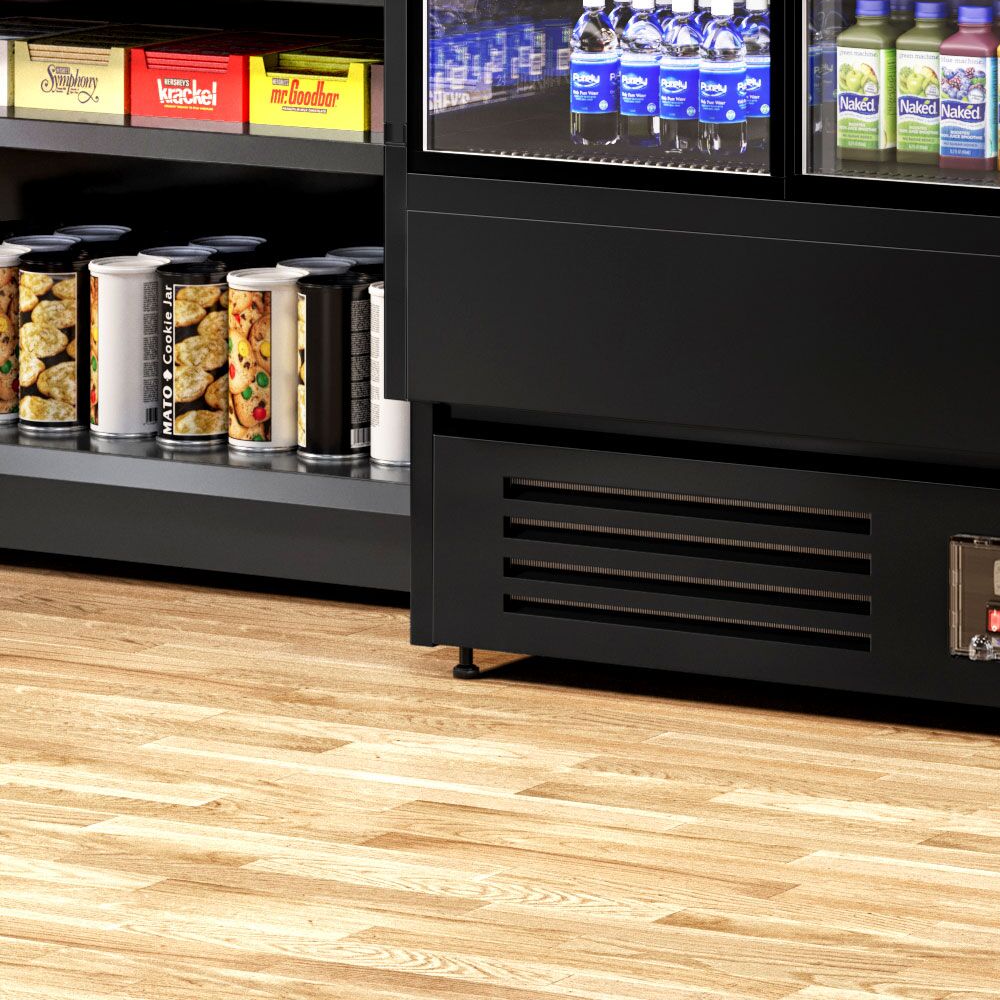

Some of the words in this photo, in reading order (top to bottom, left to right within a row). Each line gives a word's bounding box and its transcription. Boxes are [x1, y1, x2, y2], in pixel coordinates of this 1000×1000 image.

[40, 65, 99, 103] Symphony
[157, 78, 217, 106] krackel
[164, 78, 190, 87] HERSHEY'S
[840, 96, 875, 112] Naked
[901, 99, 937, 115] Naked
[941, 103, 981, 119] Naked
[162, 284, 173, 312] Jar
[162, 316, 173, 365] Cookie
[161, 386, 172, 436] MATO
